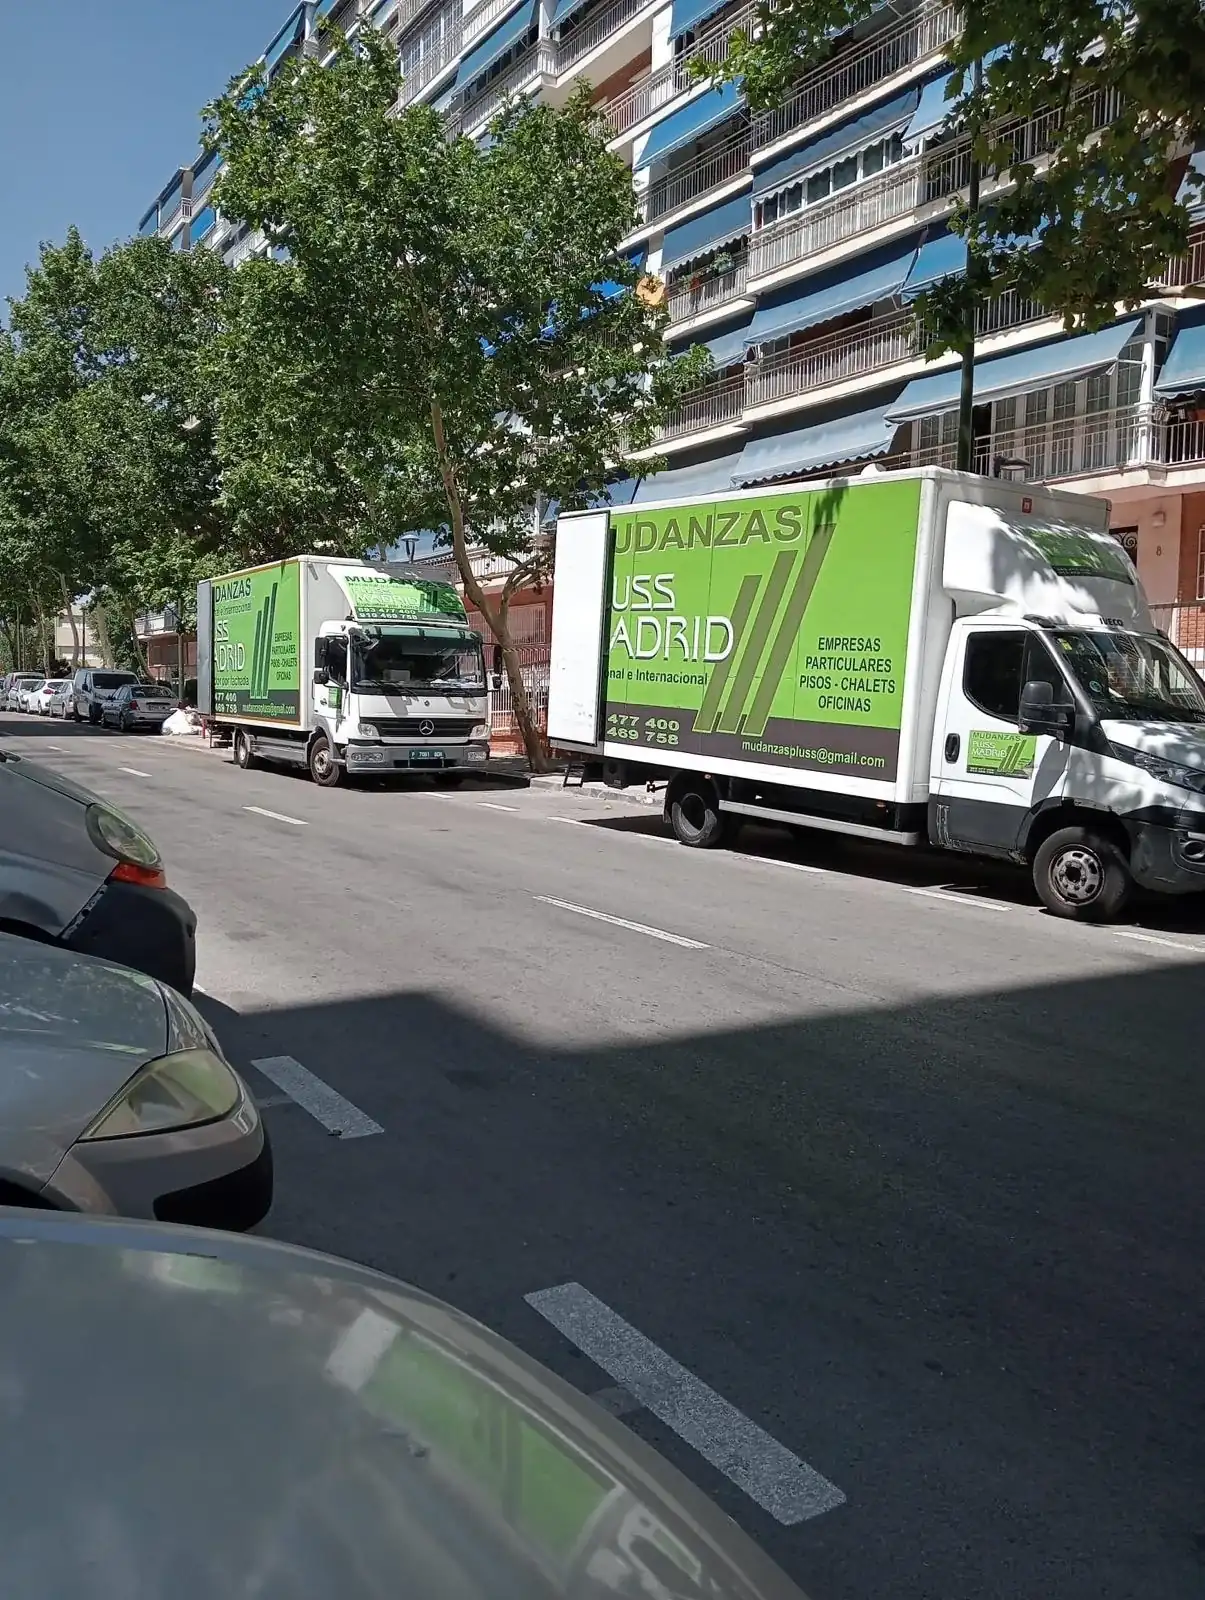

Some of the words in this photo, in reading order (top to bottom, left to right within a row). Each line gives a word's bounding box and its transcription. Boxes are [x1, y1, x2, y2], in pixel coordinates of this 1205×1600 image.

[215, 577, 251, 602] DANZAS
[612, 573, 675, 611] USS
[1100, 618, 1124, 627] IVECO
[609, 615, 734, 663] ADRID
[818, 637, 881, 652] EMPRESAS
[805, 656, 892, 673] PARTICULARES
[627, 671, 633, 680] e
[636, 668, 708, 685] Internacional
[800, 675, 832, 690] PISOS
[841, 677, 896, 694] CHALETS
[818, 695, 872, 713] OFICINAS
[607, 713, 640, 726] 477
[645, 718, 680, 731] 400
[607, 727, 639, 740] 469
[644, 731, 679, 745] 758
[972, 732, 1021, 742] MUDANZAS
[742, 740, 885, 768] mudanzaspluss@gmail.com
[972, 748, 1007, 758] MADRID
